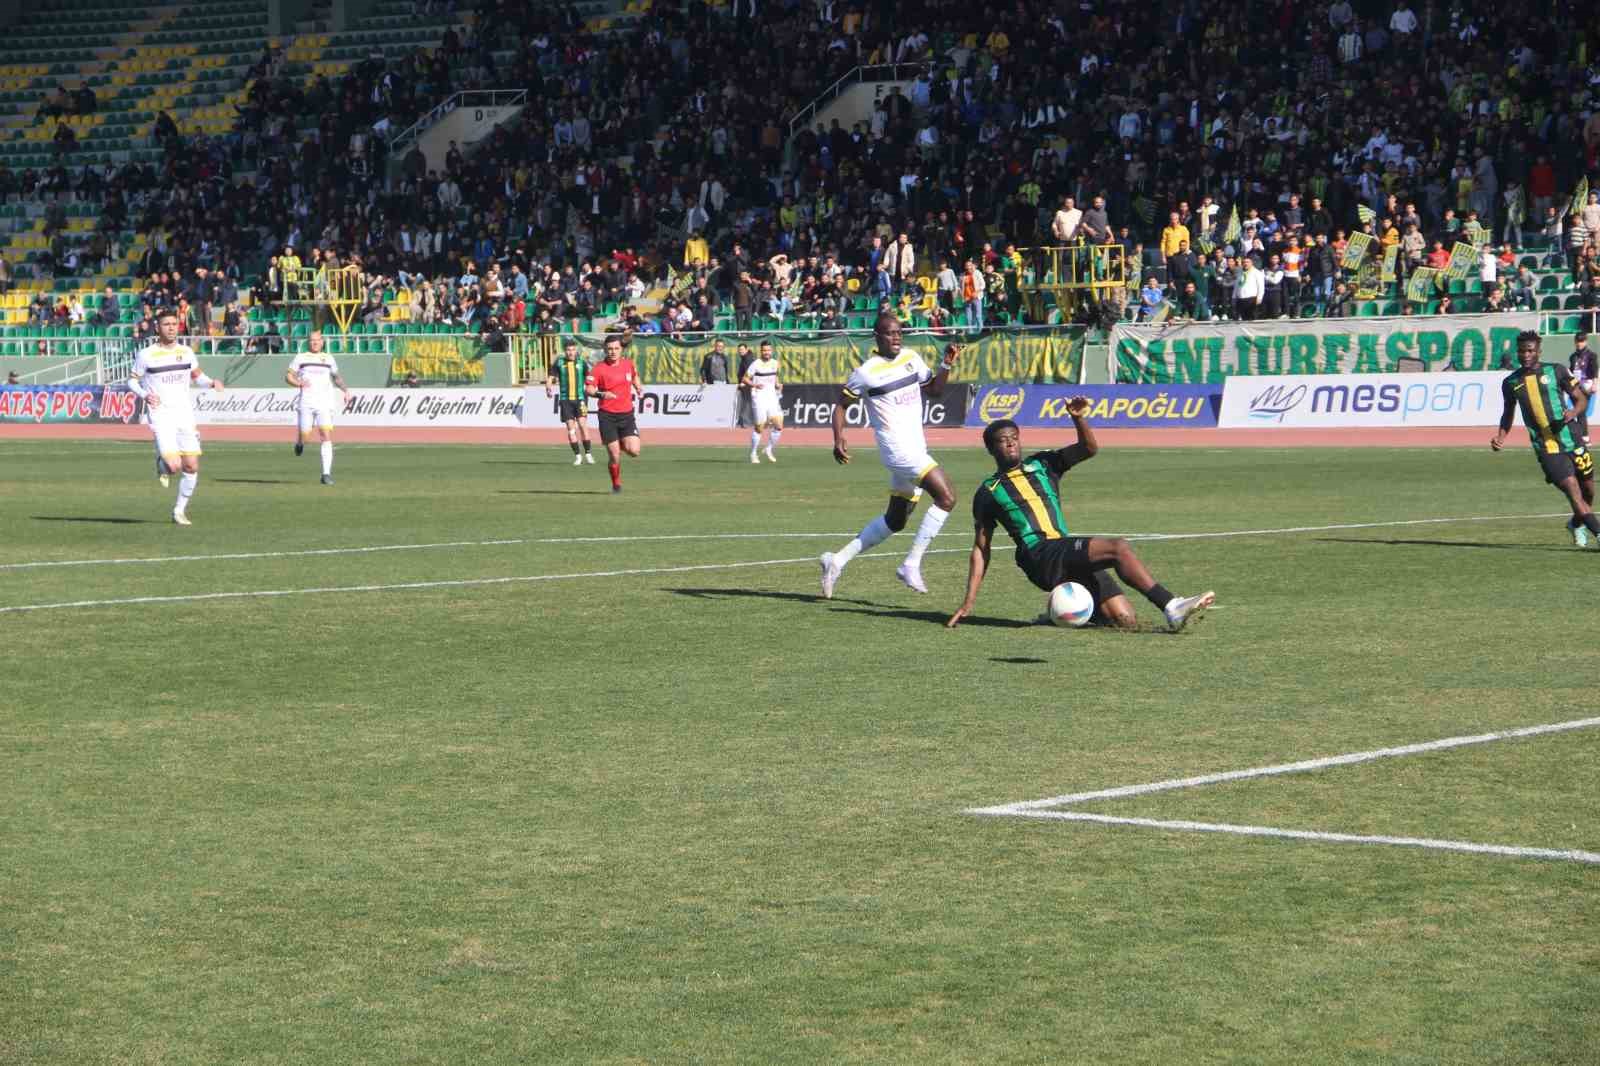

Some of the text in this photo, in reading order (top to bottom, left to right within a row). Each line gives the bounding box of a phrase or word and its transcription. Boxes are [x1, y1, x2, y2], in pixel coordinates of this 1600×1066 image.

[475, 109, 484, 121] D
[51, 391, 93, 417] PVC
[100, 385, 137, 424] İNŞ
[194, 393, 249, 413] Sembol
[342, 394, 385, 415] Akıllı
[389, 395, 410, 417] Ol,
[988, 393, 1018, 408] KSP
[1311, 382, 1484, 422] mespan
[1574, 452, 1593, 471] 32
